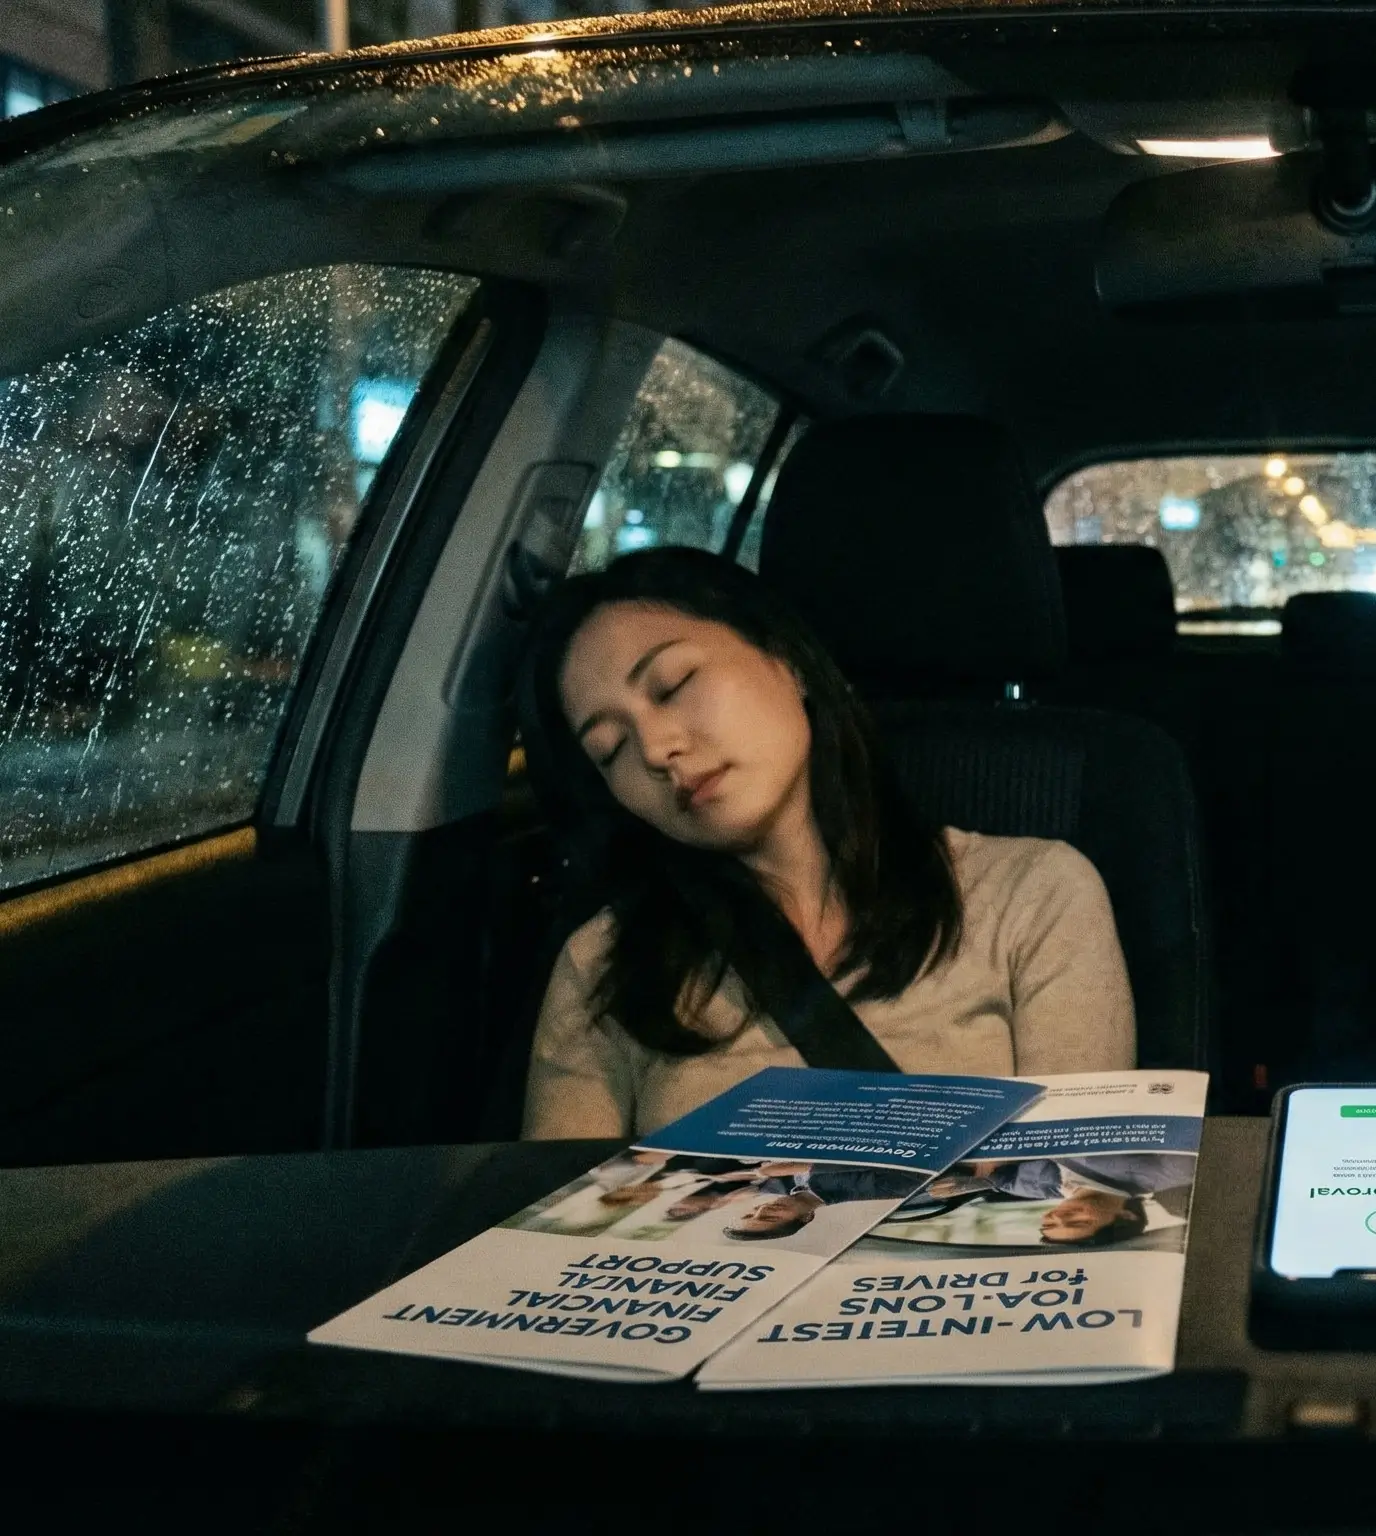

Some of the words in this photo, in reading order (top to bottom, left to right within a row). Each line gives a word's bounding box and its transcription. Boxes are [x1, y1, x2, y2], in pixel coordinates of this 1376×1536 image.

[567, 1253, 776, 1282] SUPPORT
[852, 1271, 1008, 1293] DRIVES
[1020, 1268, 1089, 1285] for
[506, 1289, 724, 1323] FINANCIAL
[382, 1304, 692, 1344] GOVERNMENT
